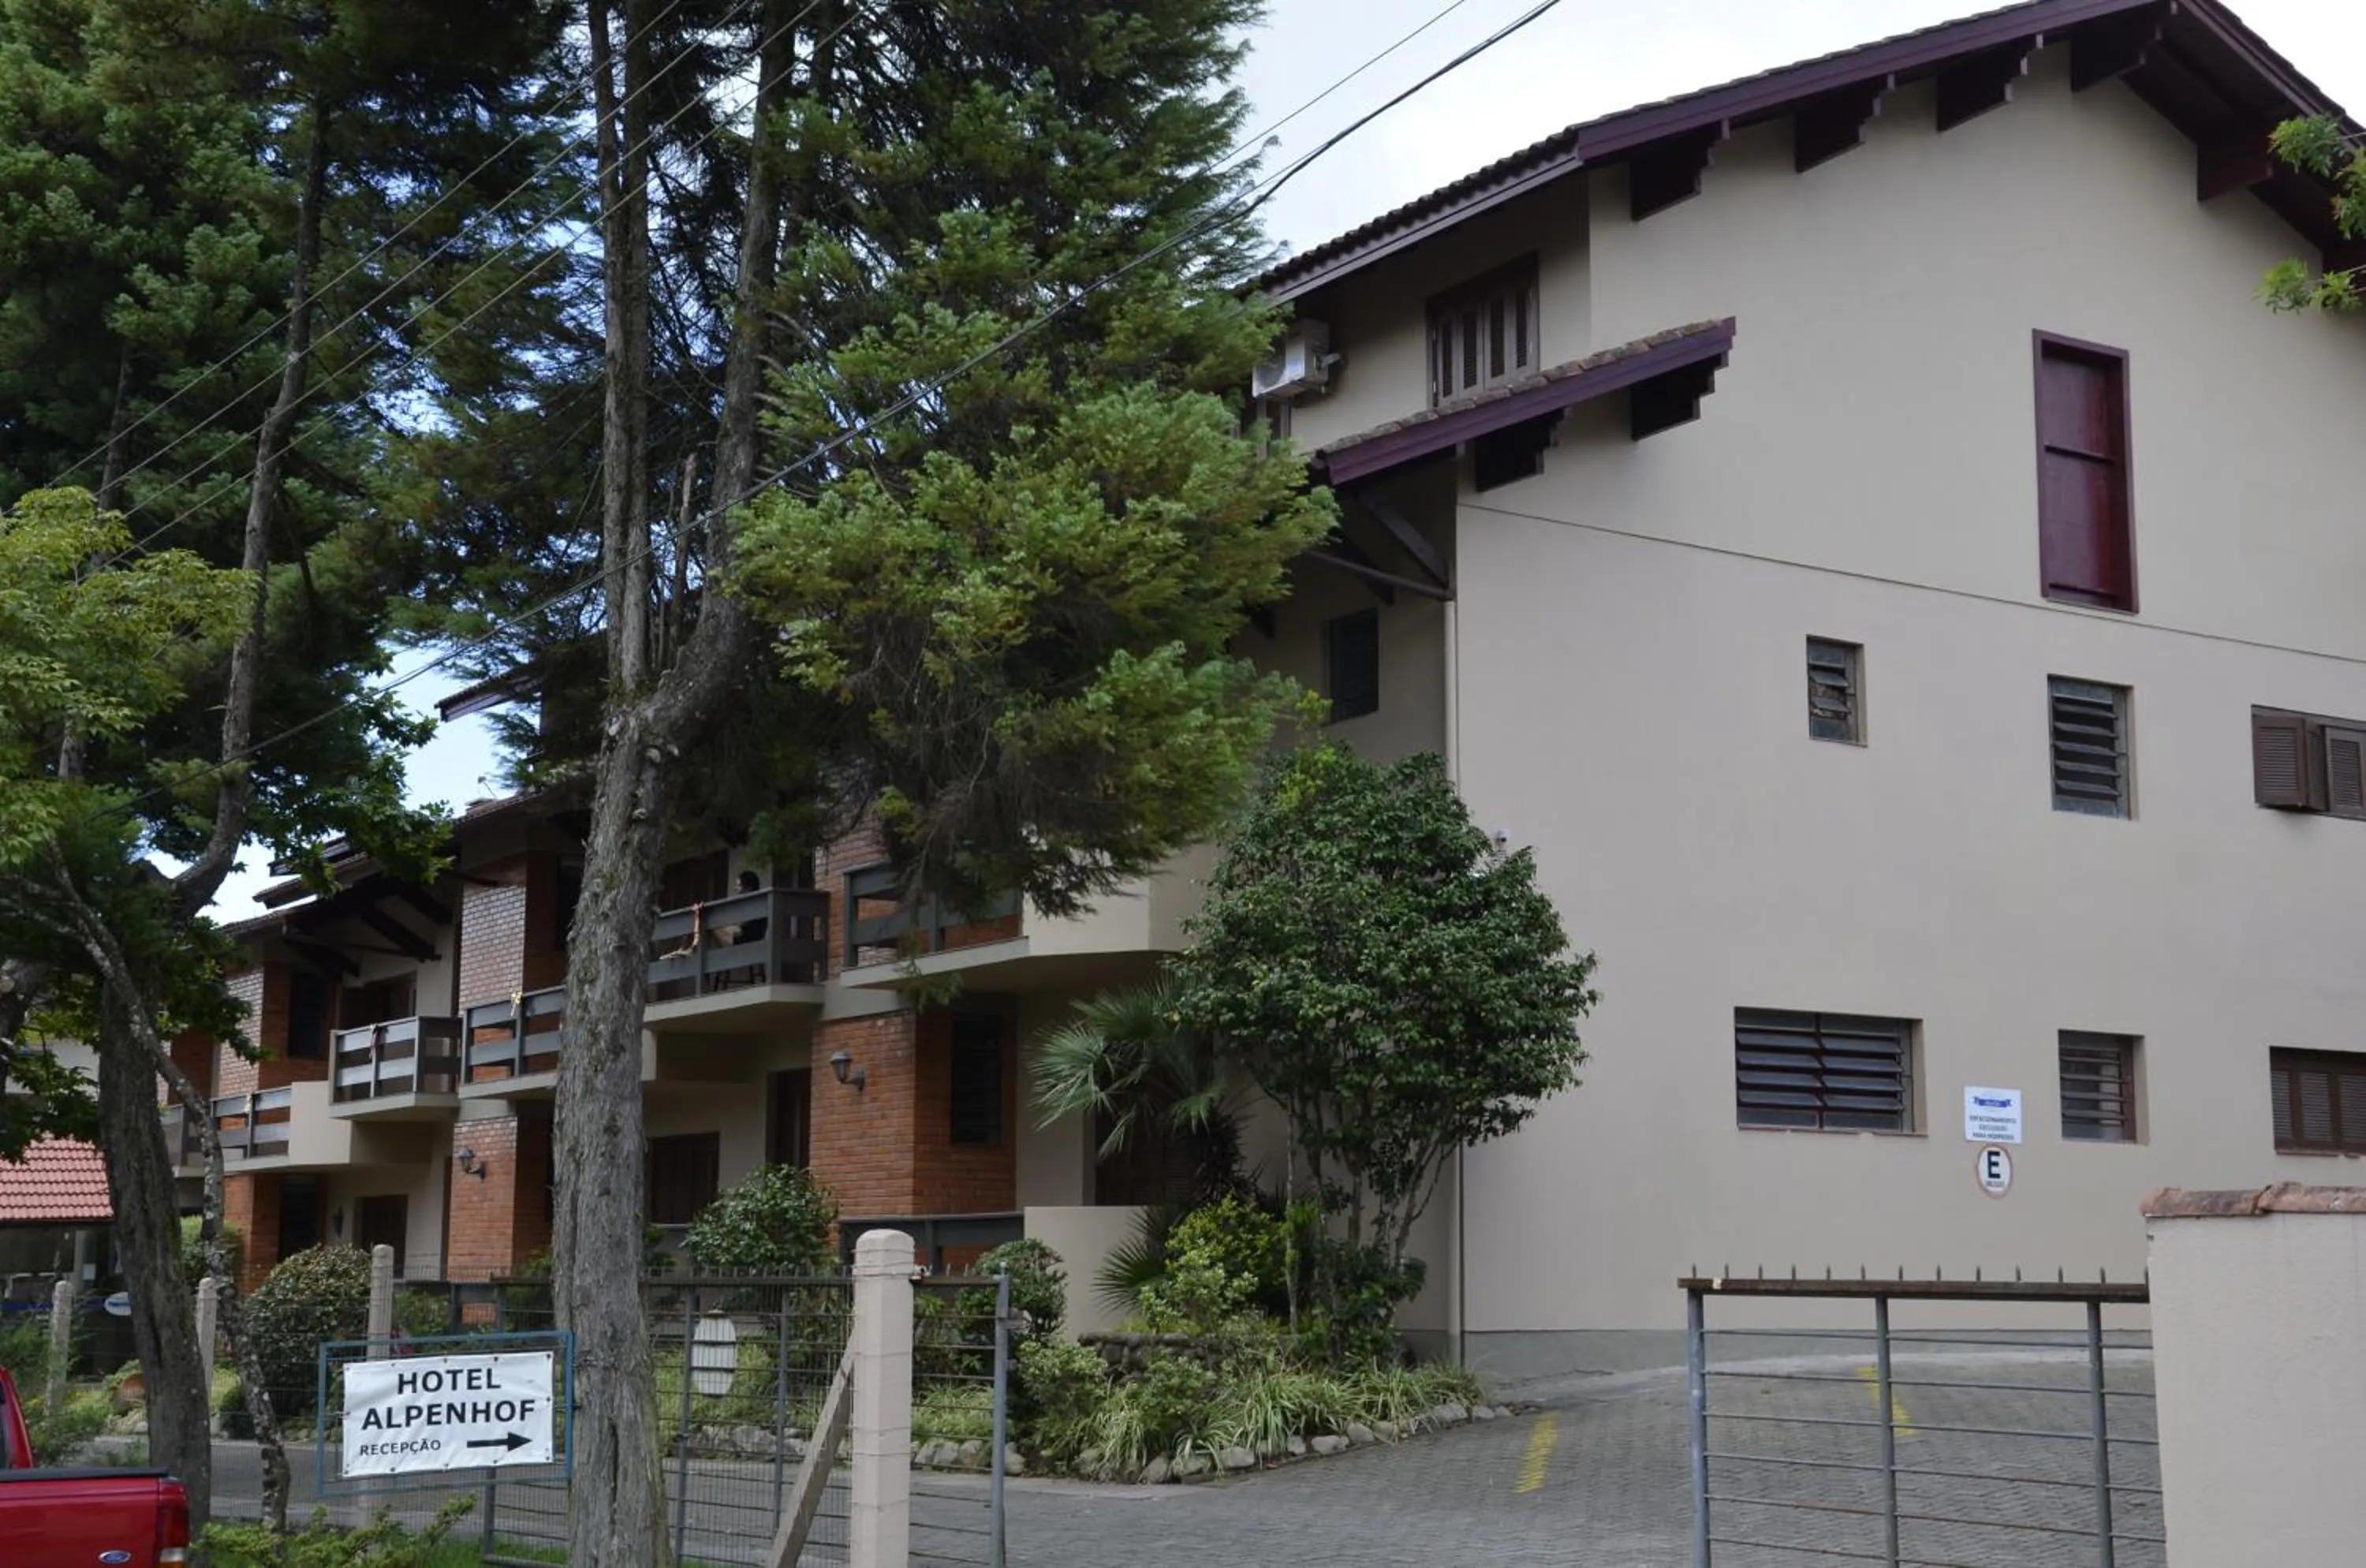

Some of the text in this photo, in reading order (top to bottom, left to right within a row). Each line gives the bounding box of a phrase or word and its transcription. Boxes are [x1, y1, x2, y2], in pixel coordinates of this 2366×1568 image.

[1987, 1150, 2001, 1178] E
[397, 1368, 502, 1394] HOTEL
[361, 1399, 536, 1430] ALPENHOF
[359, 1438, 442, 1457] RECEPÇÃO
